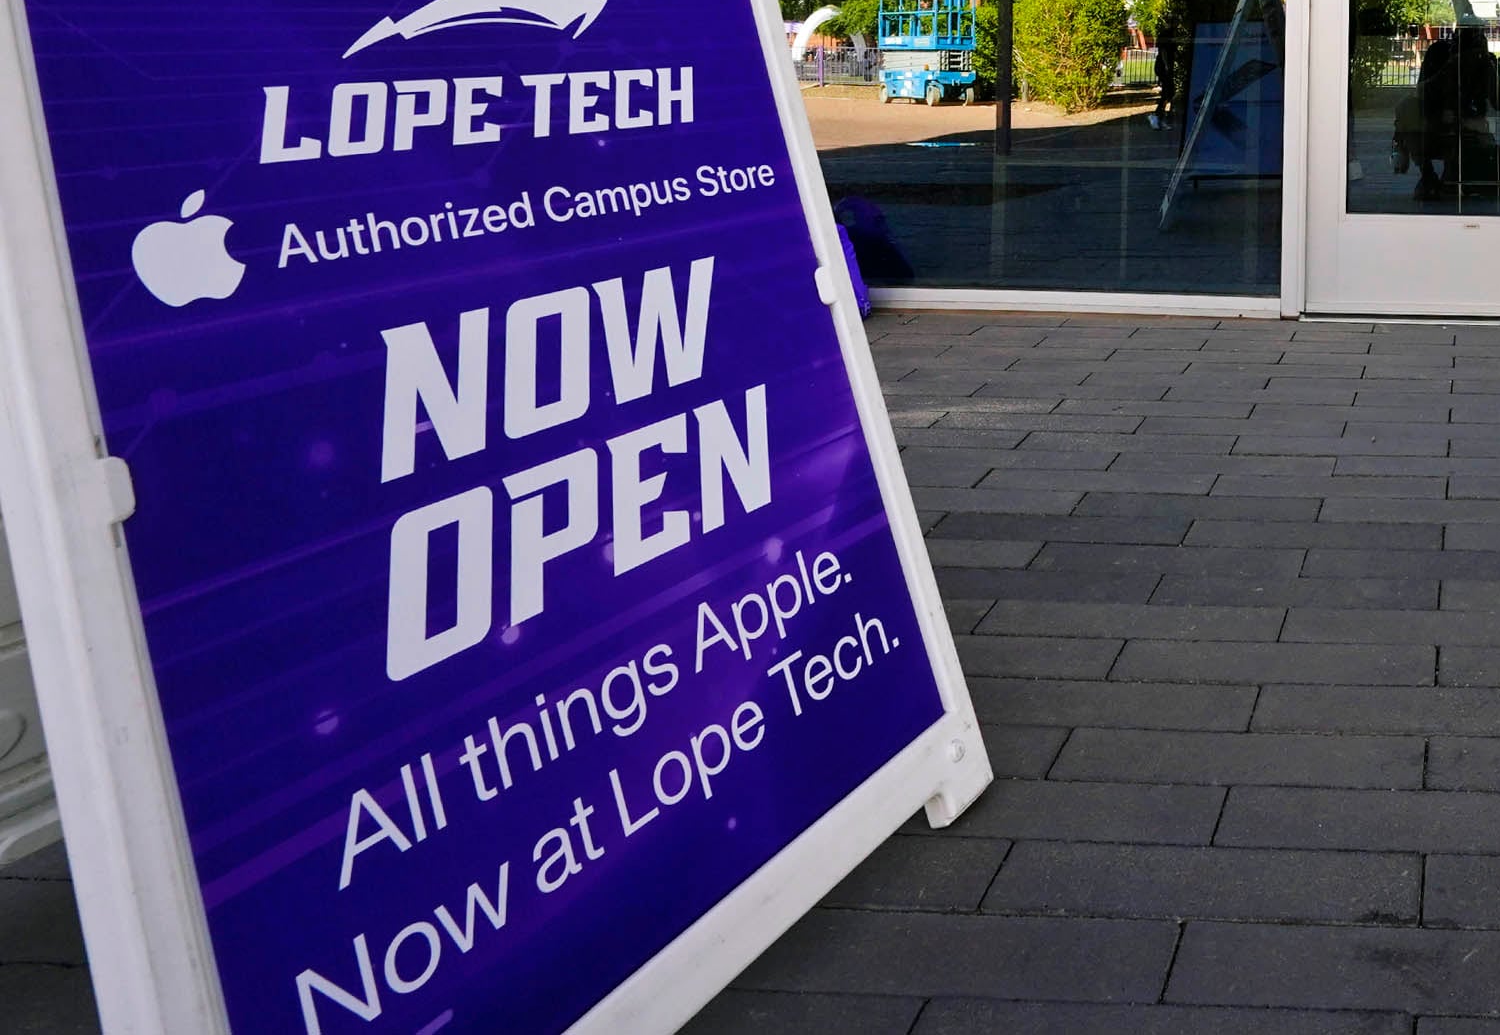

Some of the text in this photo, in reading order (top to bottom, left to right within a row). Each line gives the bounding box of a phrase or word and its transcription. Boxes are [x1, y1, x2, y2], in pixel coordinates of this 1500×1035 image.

[259, 66, 694, 164] LOPE TECH
[278, 163, 776, 269] Authorized Campus Store
[380, 256, 715, 484] NOW
[386, 383, 772, 681] OPEN
[296, 612, 901, 1035] Now at Lope Tech.
[339, 549, 853, 890] All things Apple.
